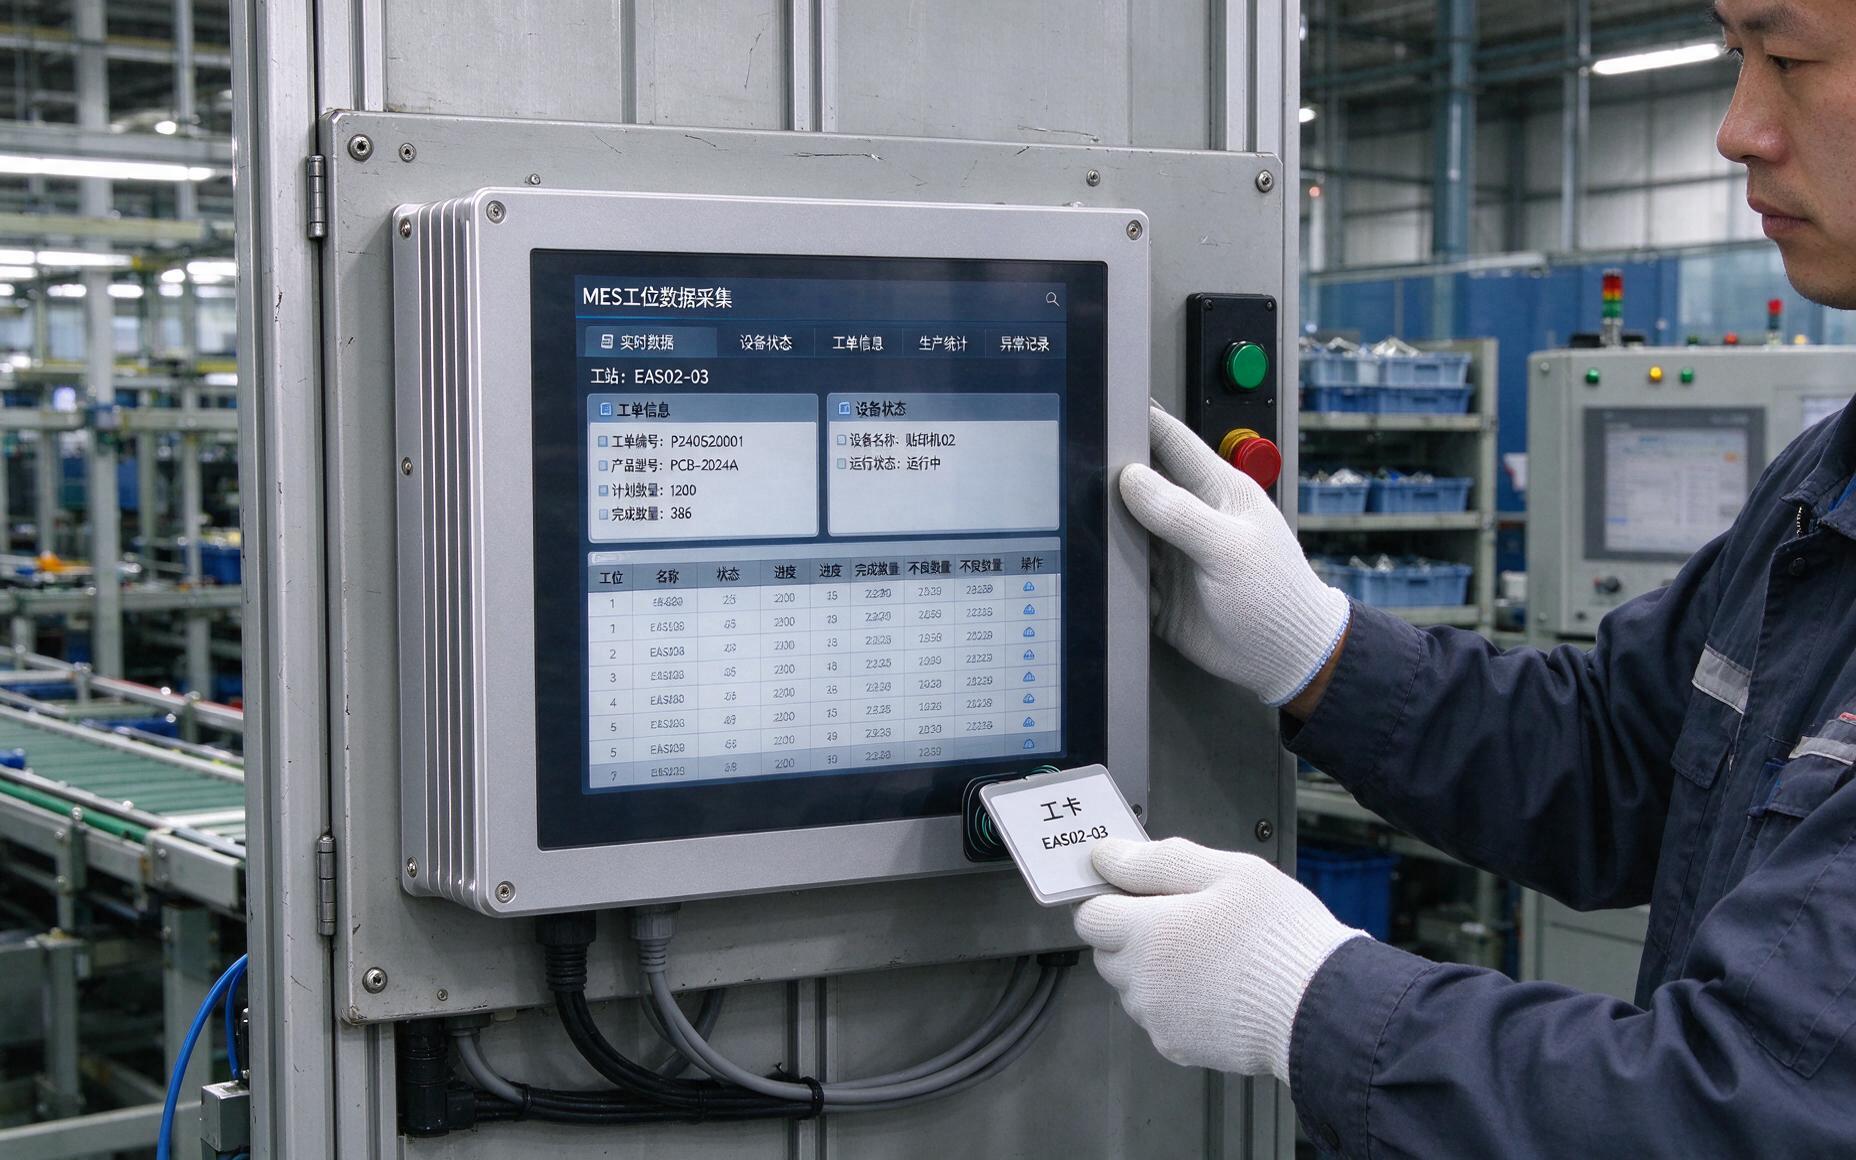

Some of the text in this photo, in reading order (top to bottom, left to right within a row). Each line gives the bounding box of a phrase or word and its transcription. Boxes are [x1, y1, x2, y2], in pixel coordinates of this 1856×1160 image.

[583, 286, 733, 309] MES工位数据采集
[620, 334, 1050, 352] 实时数据 设备状态 工单信息 生产统计 异常记录
[634, 369, 709, 384] EAS02-03
[616, 401, 671, 419] 工单信息
[855, 400, 908, 418] 设备状态
[670, 458, 739, 472] PCB-2024A
[906, 455, 941, 471] 运行中
[670, 483, 697, 497] 1200
[670, 506, 692, 520] 386
[599, 570, 624, 585] 工位
[656, 569, 680, 584] 名称
[609, 649, 617, 660] 2
[609, 672, 617, 683] 3
[609, 698, 617, 709] 4
[610, 722, 617, 732] 5
[610, 747, 617, 758] 5
[1040, 796, 1082, 822] 工卡
[1041, 825, 1109, 850] EAS02-03
